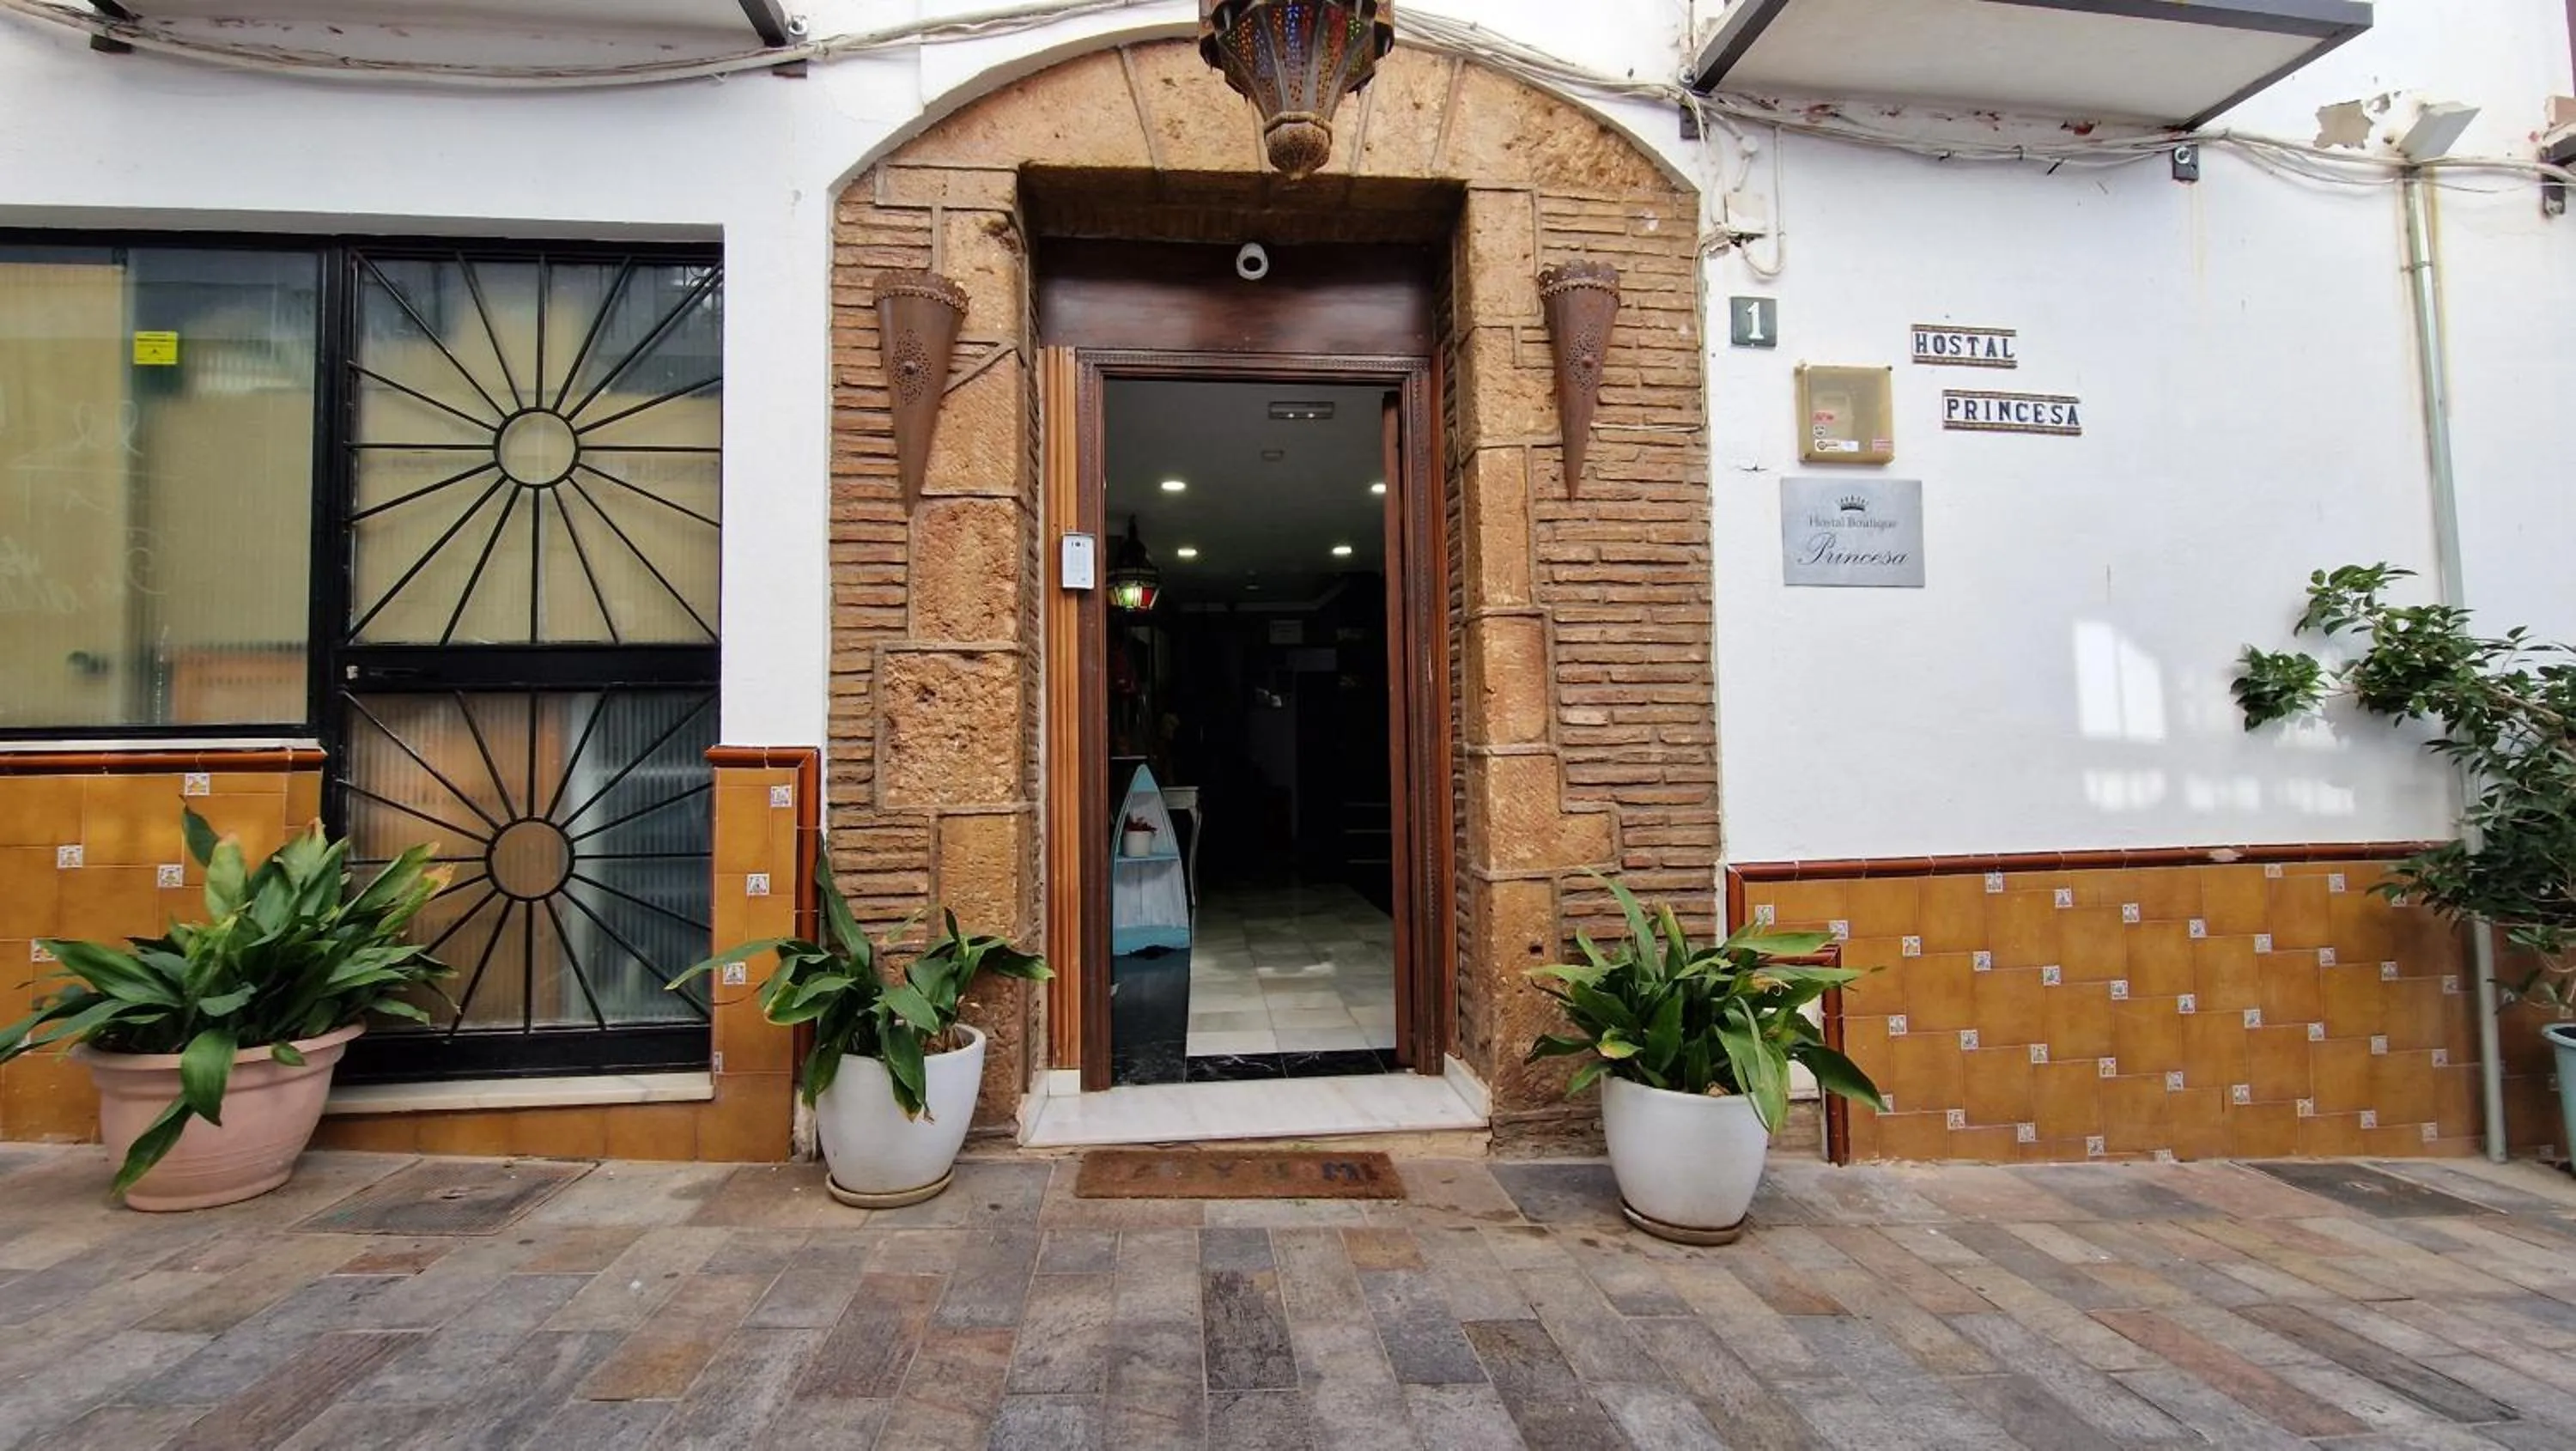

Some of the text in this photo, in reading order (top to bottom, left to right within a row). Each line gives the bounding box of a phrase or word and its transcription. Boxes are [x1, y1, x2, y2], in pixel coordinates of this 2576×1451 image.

[1746, 301, 1765, 340] 1
[1915, 332, 2015, 359] HOSTAL
[1946, 398, 2080, 426] PRINCESA
[1809, 515, 1898, 531] Hostal Boutique
[1796, 531, 1910, 565] Princesa
